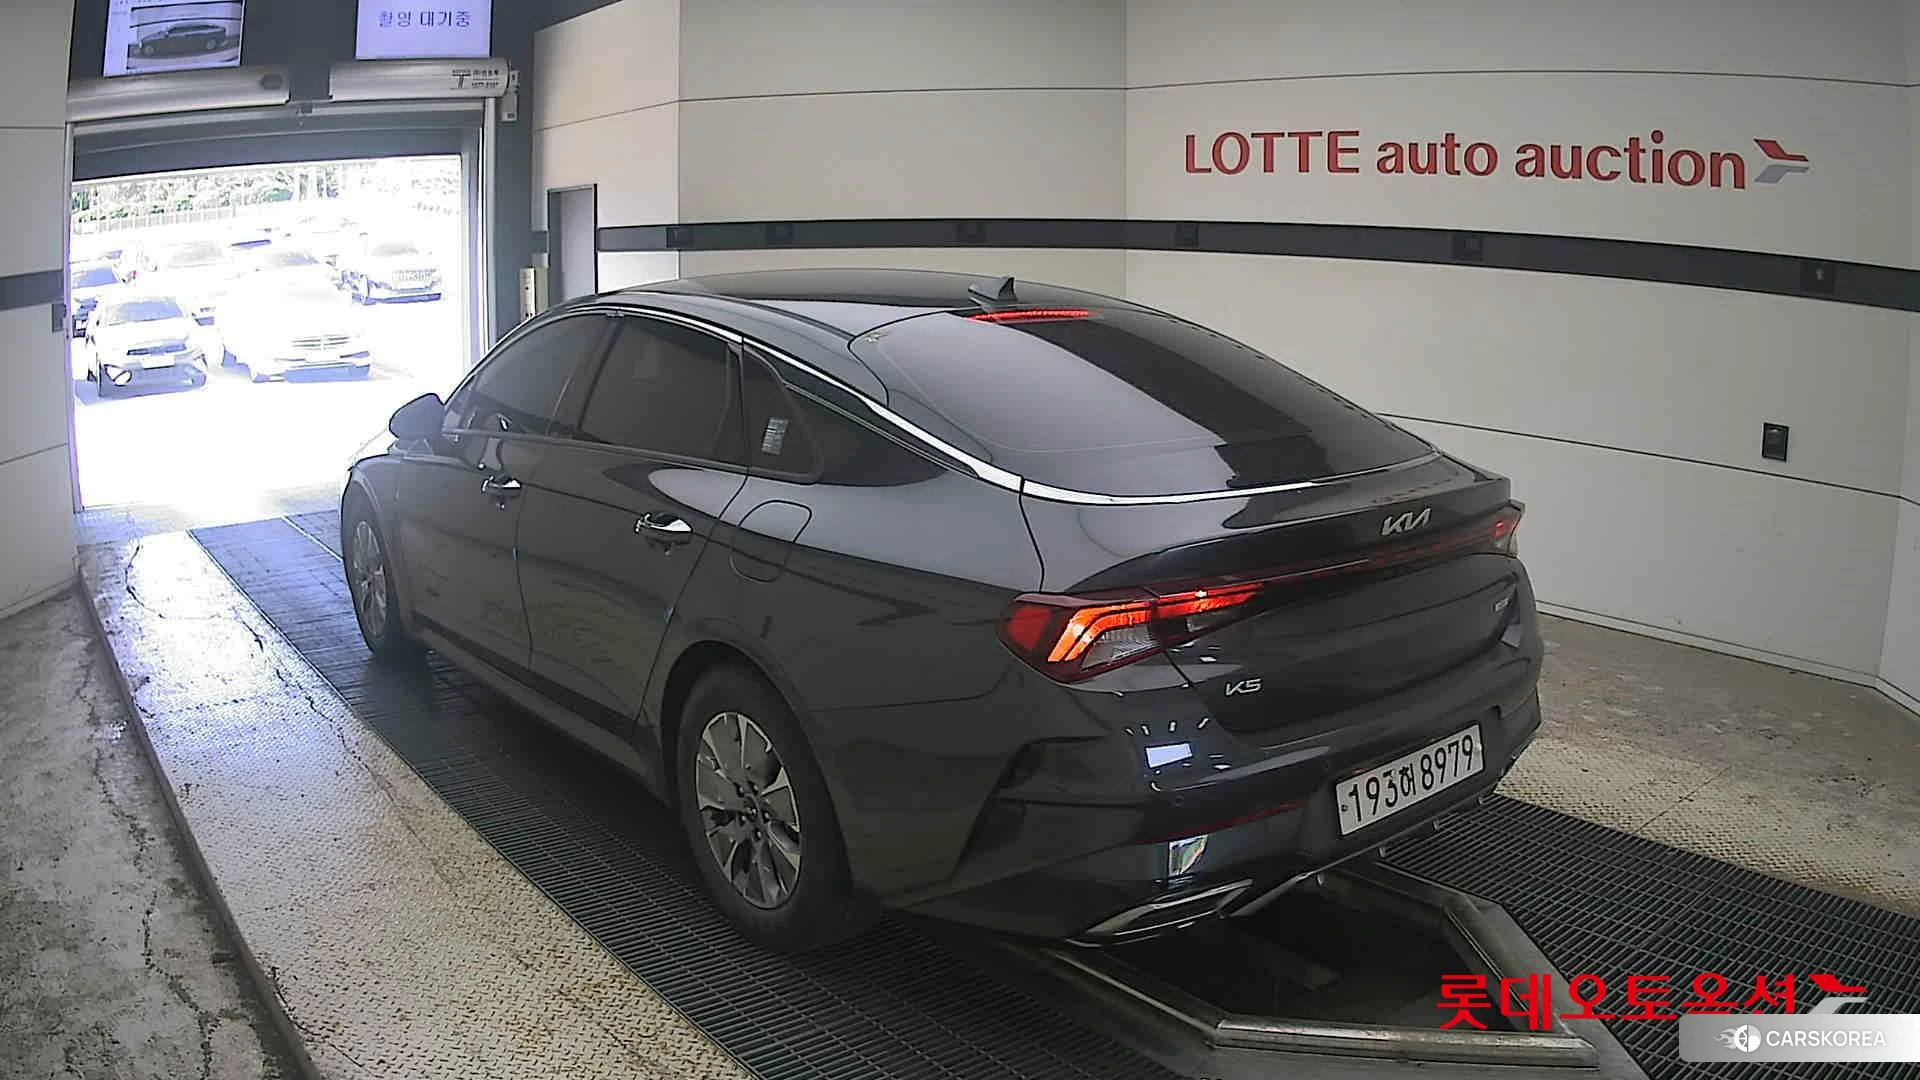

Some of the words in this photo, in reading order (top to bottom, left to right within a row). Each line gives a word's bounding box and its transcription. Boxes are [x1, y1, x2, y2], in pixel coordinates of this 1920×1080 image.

[379, 10, 412, 28] 촬영
[420, 10, 471, 28] 대기중
[1185, 130, 1360, 175] LOTTE
[1376, 132, 1499, 176] auto
[1514, 129, 1746, 190] auction
[1225, 678, 1262, 696] K5
